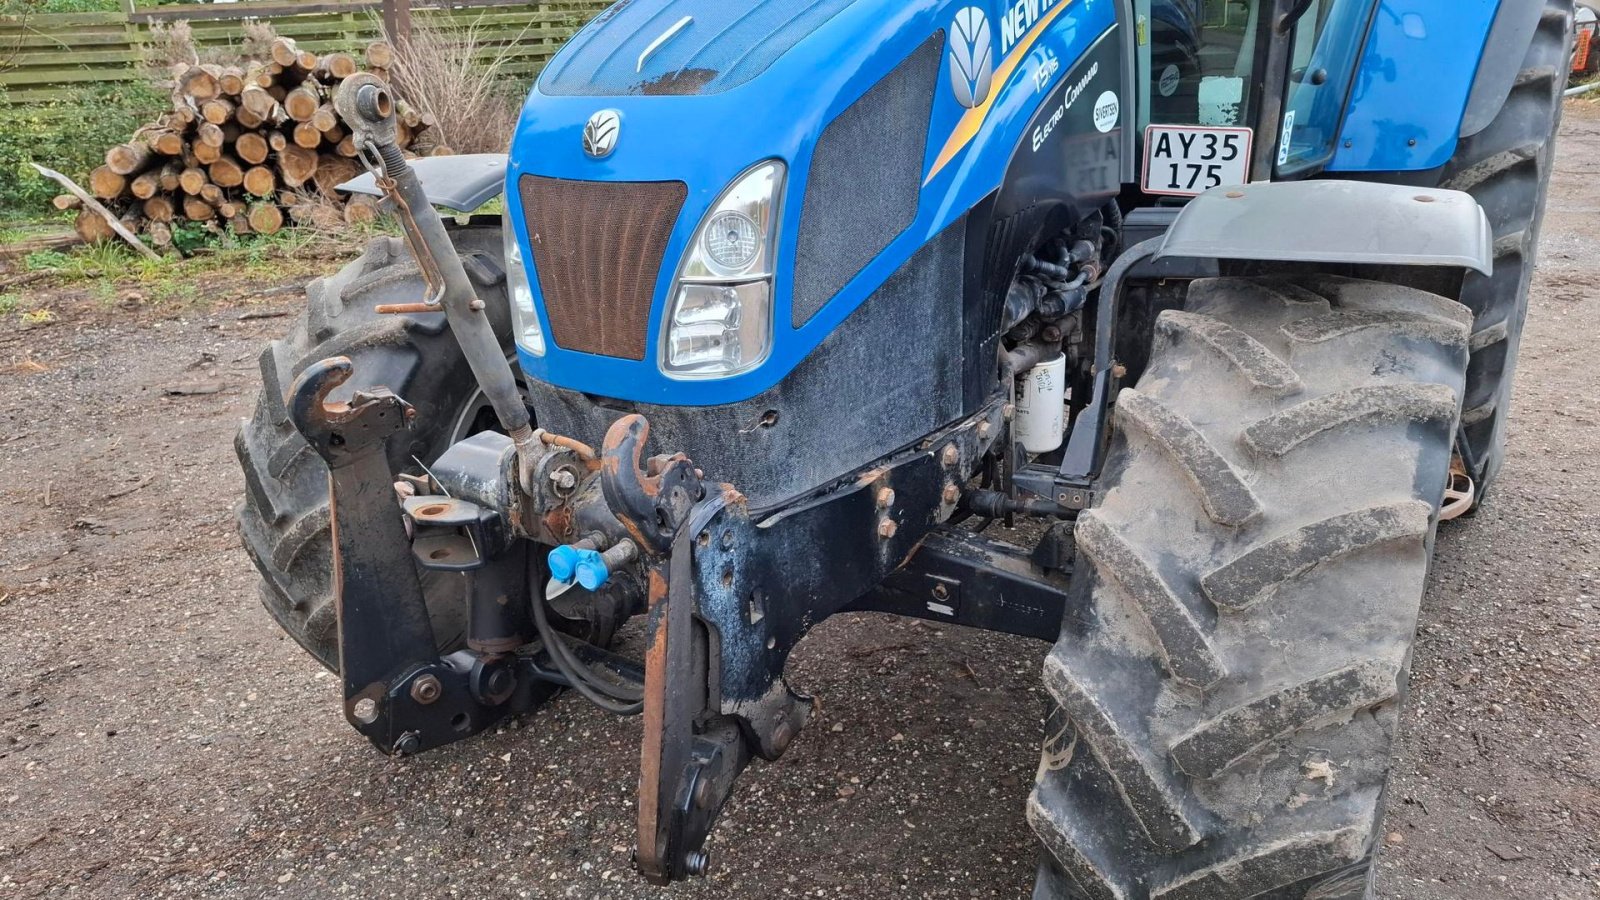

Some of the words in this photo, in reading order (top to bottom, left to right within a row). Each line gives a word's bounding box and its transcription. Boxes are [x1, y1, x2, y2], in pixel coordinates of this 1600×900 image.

[1095, 102, 1119, 122] SIVERTSEN
[1154, 132, 1239, 161] AY35
[1167, 163, 1223, 190] 175
